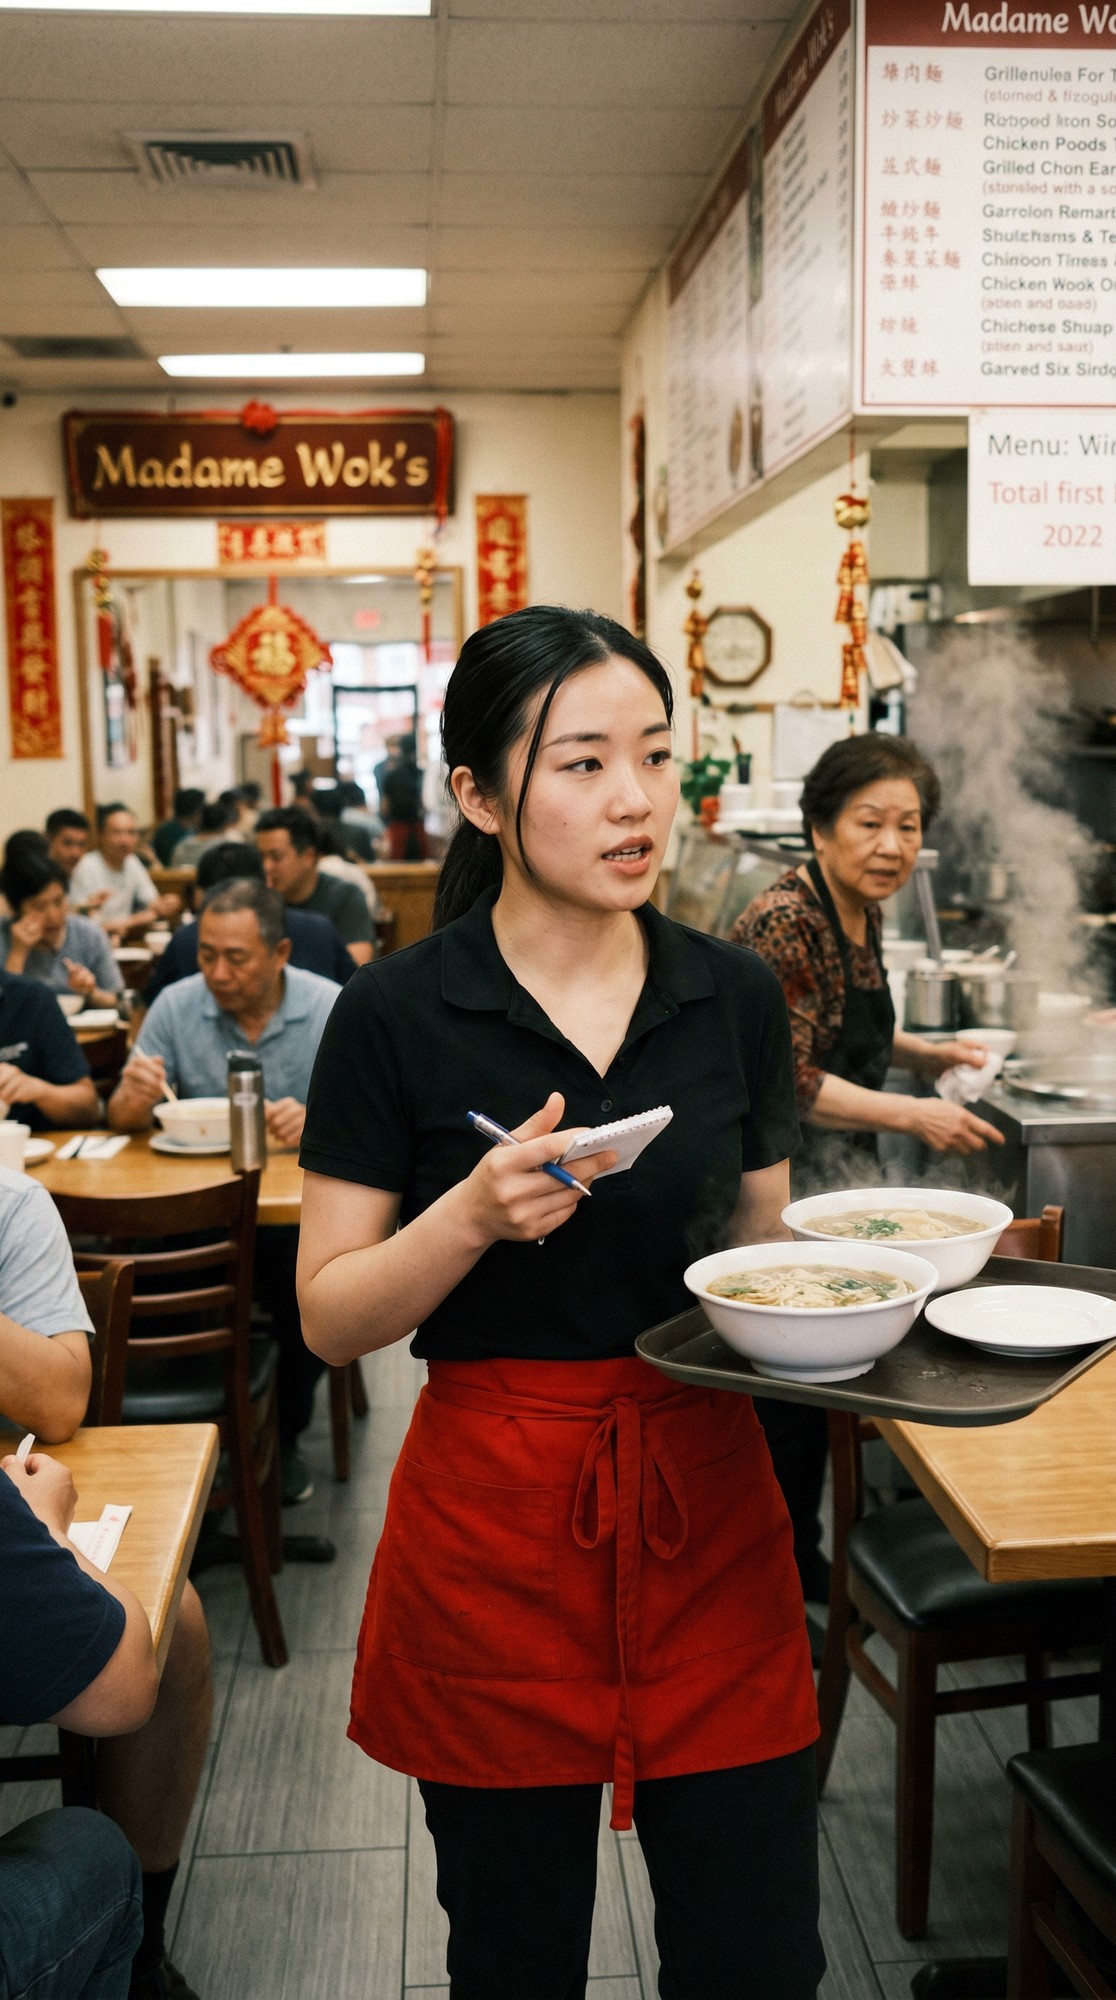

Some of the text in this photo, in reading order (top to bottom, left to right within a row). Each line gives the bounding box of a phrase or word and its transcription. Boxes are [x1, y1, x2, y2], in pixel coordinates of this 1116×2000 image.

[941, 2, 1069, 33] Madame
[1078, 68, 1104, 82] For
[983, 136, 1106, 151] Chicken Poods
[983, 160, 1035, 175] Grilled
[1041, 161, 1083, 175] Chon
[1053, 182, 1082, 195] with
[1088, 185, 1095, 195] a
[1082, 230, 1093, 243] &
[981, 276, 1047, 291] Chicken
[1026, 297, 1054, 310] and
[1026, 340, 1053, 353] and
[981, 361, 1039, 376] Garved
[1045, 362, 1070, 376] Six
[987, 433, 1069, 456] Menu:
[94, 441, 431, 491] Madame Wok's
[988, 480, 1105, 504] Total first
[1042, 524, 1104, 547] 2022
